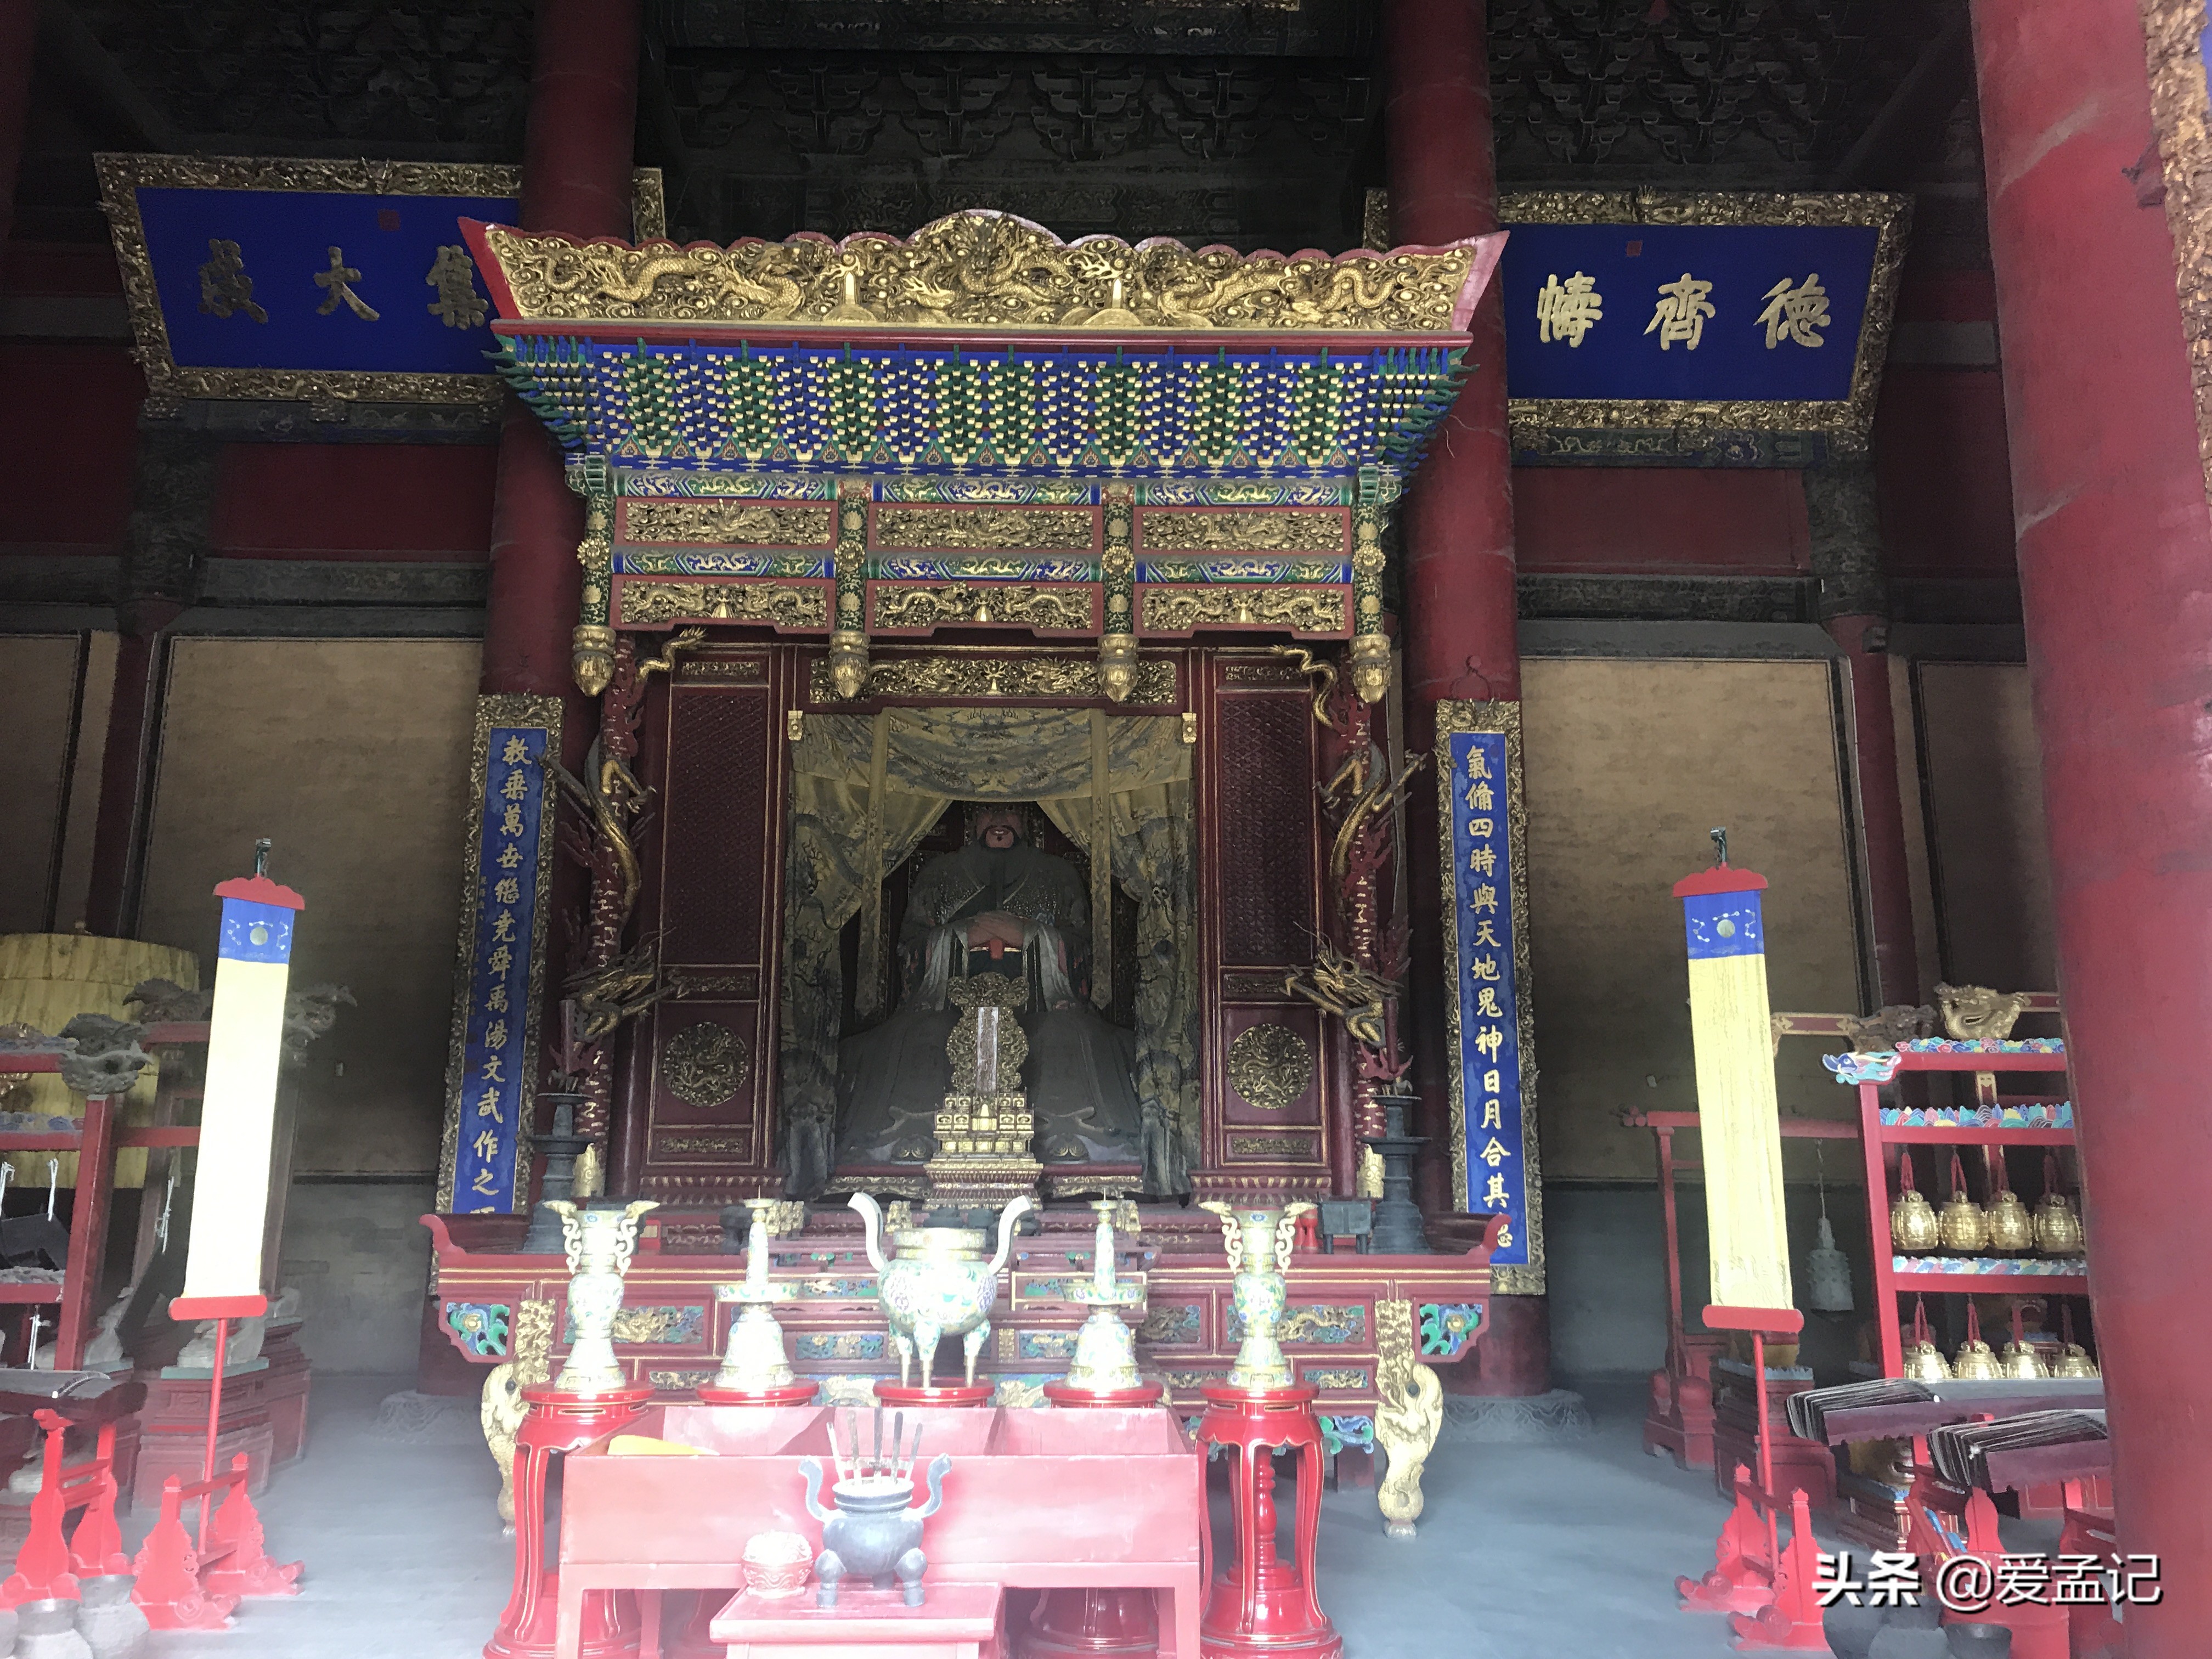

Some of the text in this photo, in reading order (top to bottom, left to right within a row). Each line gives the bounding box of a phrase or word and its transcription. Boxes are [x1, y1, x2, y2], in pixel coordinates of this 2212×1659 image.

[470, 734, 532, 1214] 教垂萬世繼堯舜禹湯文武作之
